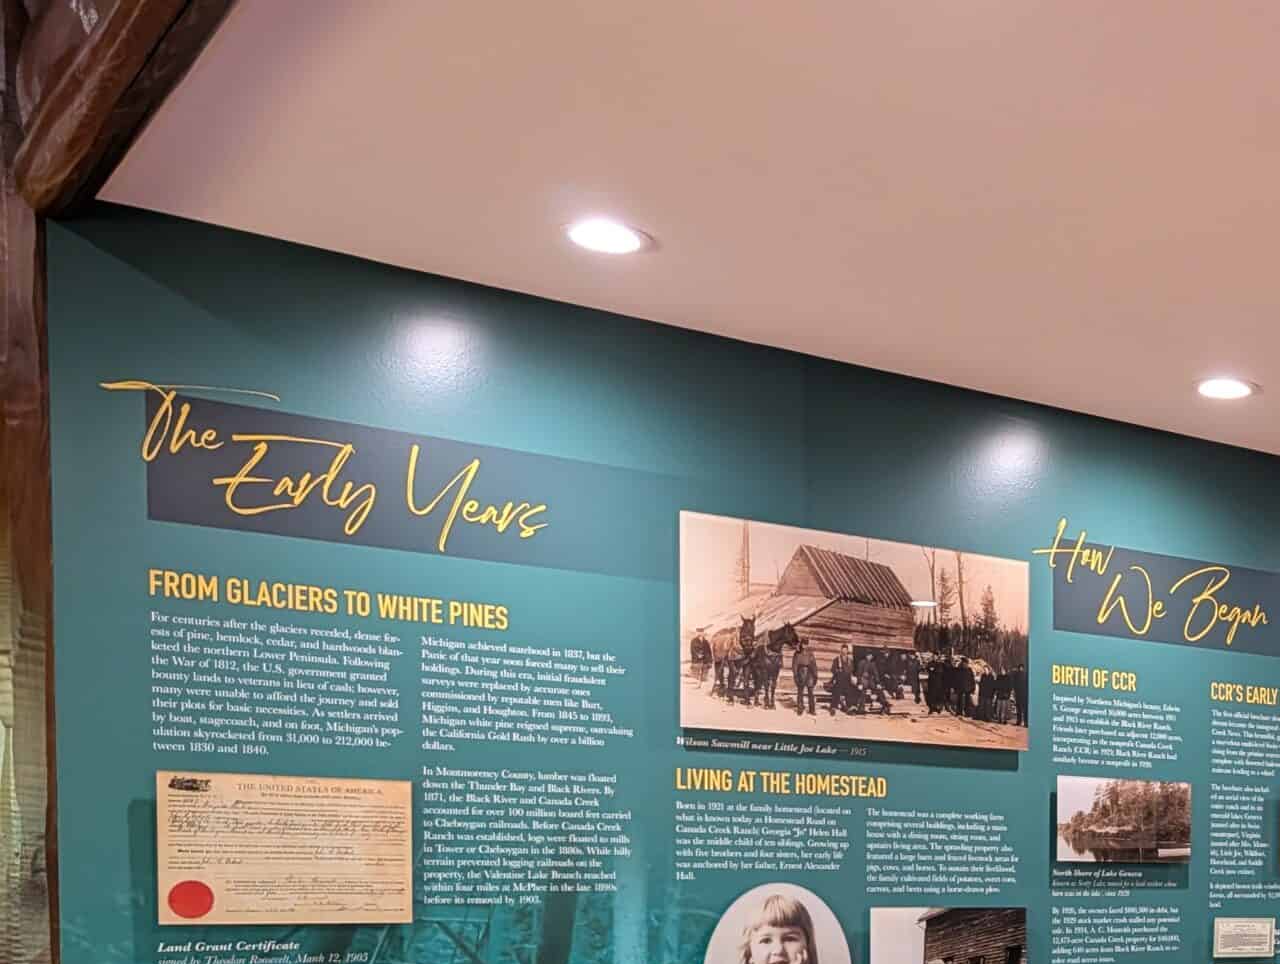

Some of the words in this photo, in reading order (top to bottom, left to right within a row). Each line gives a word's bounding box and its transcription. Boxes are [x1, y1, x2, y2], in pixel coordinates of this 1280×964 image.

[99, 379, 280, 461] The
[212, 433, 378, 535] Early
[406, 444, 549, 552] Years
[1032, 517, 1115, 584] How
[148, 569, 219, 599] FROM
[225, 577, 338, 613] GLACIERS
[344, 590, 371, 616] TO
[377, 594, 443, 624] WHITE
[448, 600, 508, 629] PINES
[1096, 565, 1167, 636] We
[1169, 566, 1269, 646] Began
[151, 654, 168, 664] the
[172, 656, 196, 667] War
[198, 658, 210, 668] of
[214, 659, 239, 672] 1812,
[243, 662, 259, 671] the
[262, 662, 285, 674] U.S.
[288, 668, 346, 679] government
[350, 670, 389, 681] granted
[152, 668, 190, 683] bounty
[193, 671, 221, 683] lands
[237, 677, 280, 687] veterans
[283, 678, 293, 688] in
[296, 679, 314, 689] lieu
[317, 681, 329, 690] of
[329, 682, 354, 693] cash;
[357, 683, 399, 696] however,
[1053, 665, 1089, 686] BIRTH
[1093, 668, 1108, 689] OF
[1112, 672, 1138, 691] CCR
[1211, 684, 1244, 702] CCR'S
[1244, 688, 1279, 705] EARLY
[153, 742, 185, 751] tween
[190, 742, 214, 752] 1830
[217, 744, 237, 753] and
[243, 744, 269, 754] 1840.
[675, 768, 732, 791] LIVING
[738, 771, 757, 793] AT
[760, 771, 789, 795] THE
[795, 774, 889, 798] HOMESTEAD
[157, 942, 192, 952] Land
[195, 942, 232, 951] Grant
[236, 940, 299, 952] Certificate
